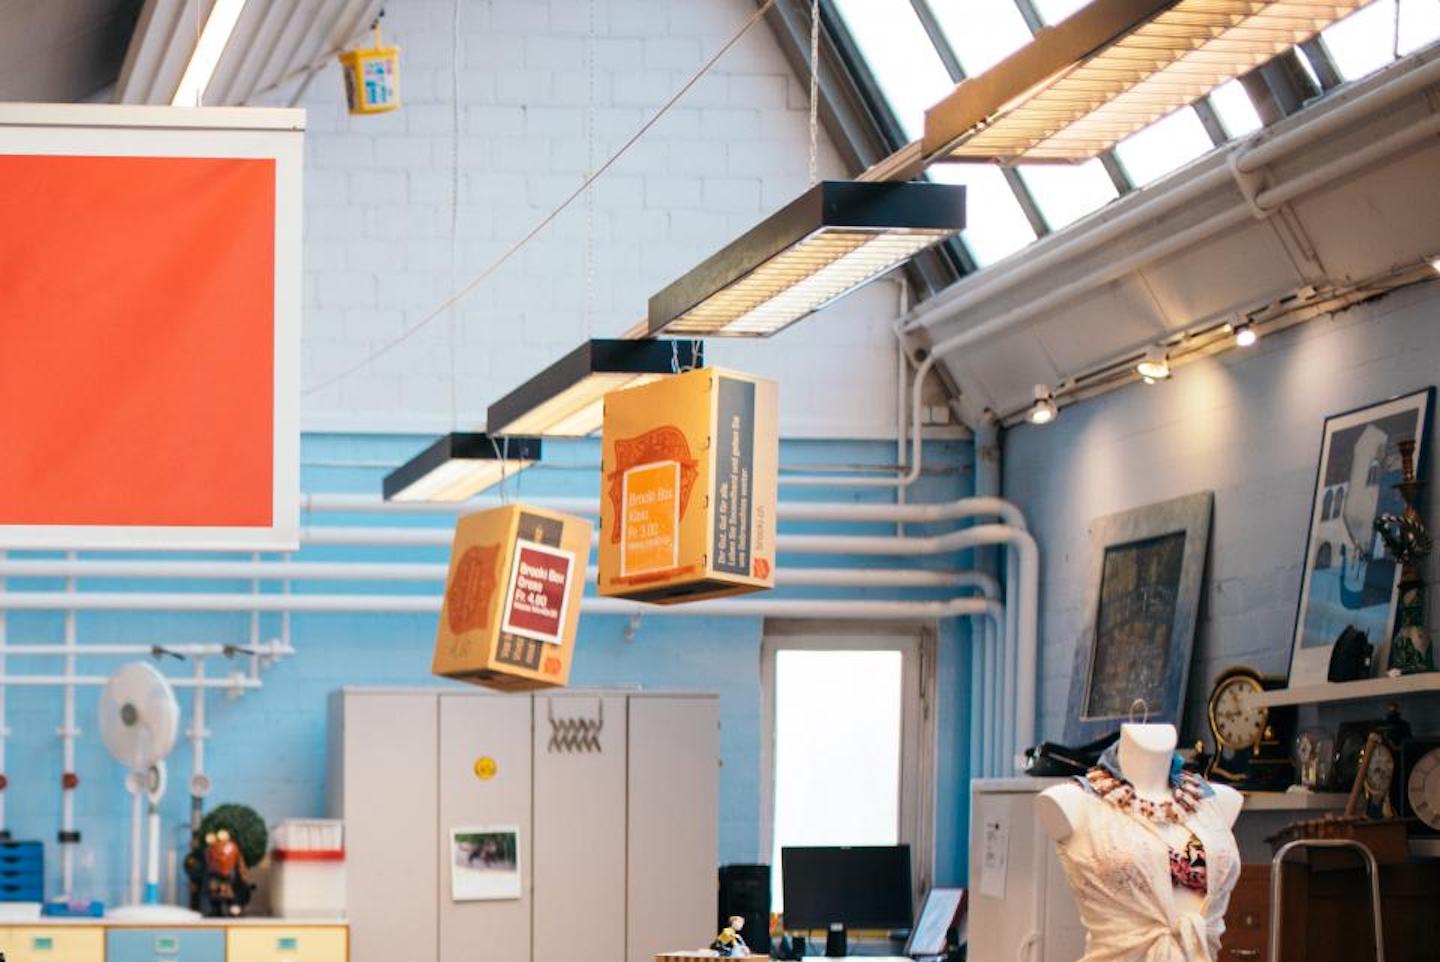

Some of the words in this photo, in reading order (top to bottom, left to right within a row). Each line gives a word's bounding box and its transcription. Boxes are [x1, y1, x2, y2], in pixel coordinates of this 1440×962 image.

[757, 505, 765, 550] brocki.ch
[520, 562, 548, 580] Brocki
[548, 568, 565, 584] Box
